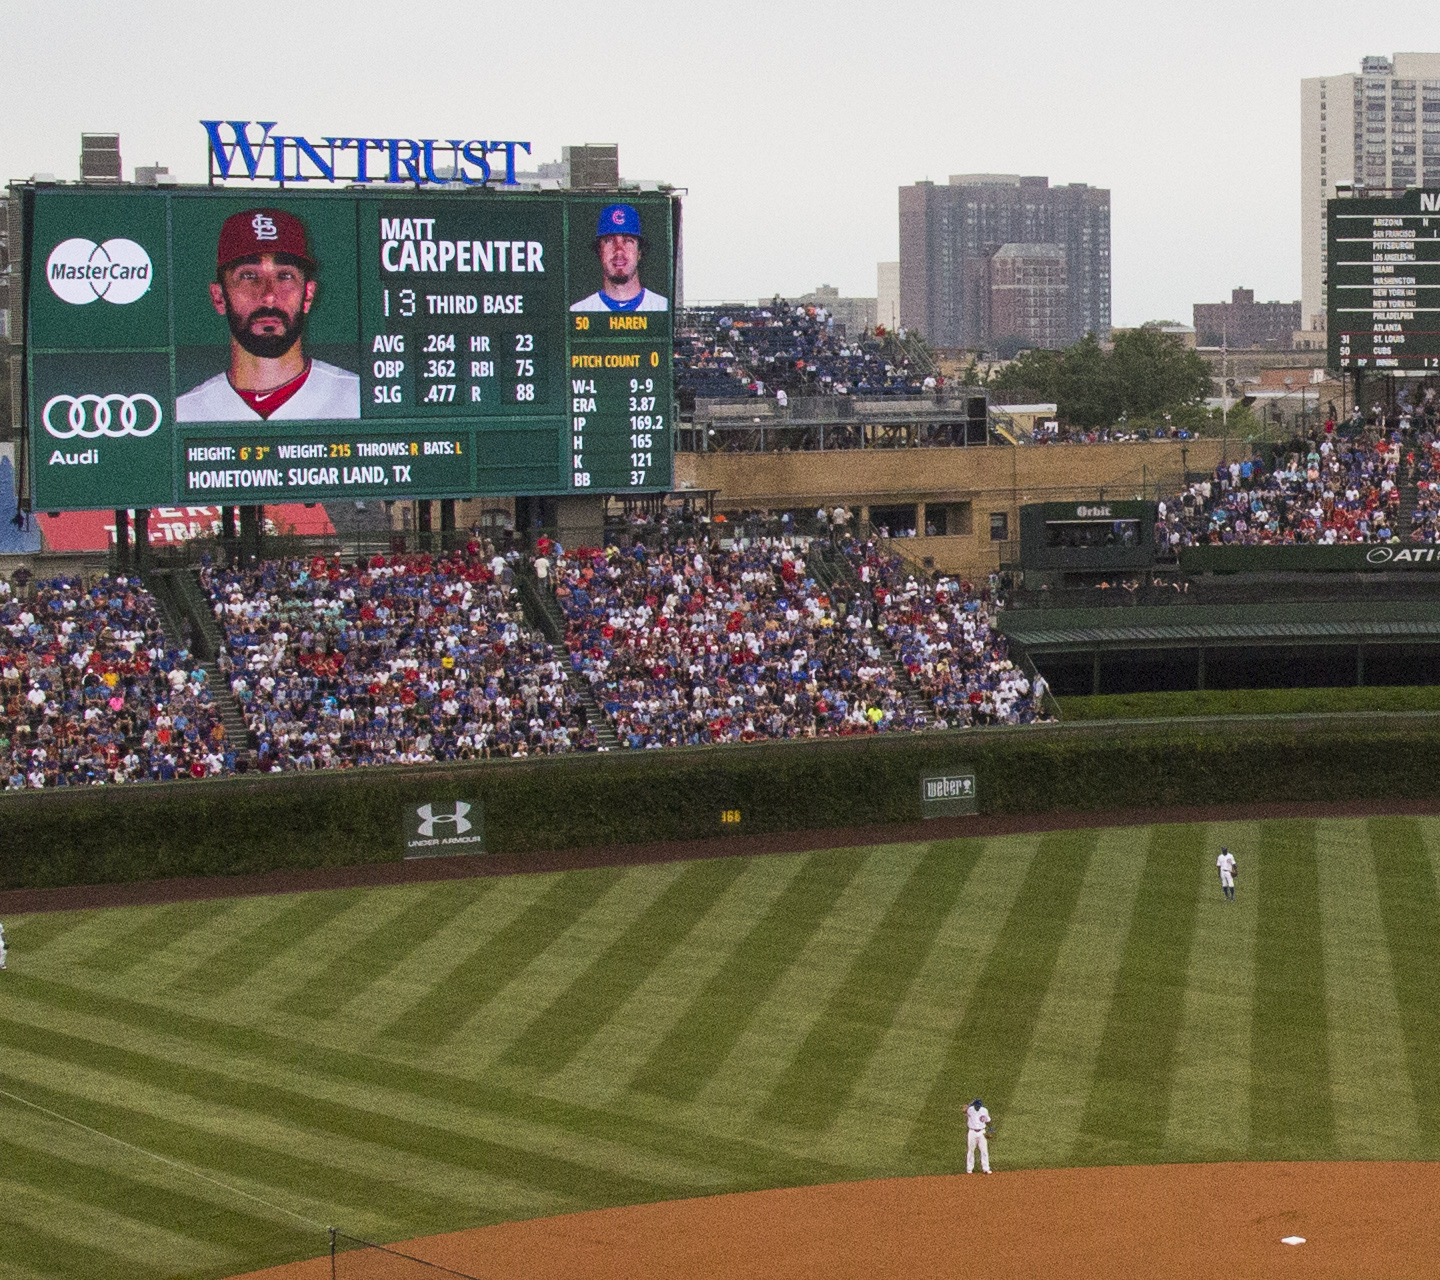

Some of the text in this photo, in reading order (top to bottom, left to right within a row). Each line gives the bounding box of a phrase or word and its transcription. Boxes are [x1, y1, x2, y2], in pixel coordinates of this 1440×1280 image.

[200, 120, 531, 185] WINTRUST
[381, 219, 435, 239] MATT
[381, 241, 544, 272] CARPENTER
[51, 264, 148, 280] MasterCard
[384, 289, 523, 316] 13 THIRD BASE
[576, 317, 647, 330] 50 HAREN
[373, 334, 533, 352] AVG .264 HR 23
[572, 352, 658, 367] PITCH COUNT 0
[374, 359, 533, 378] OBP .362 RBI 75
[374, 384, 534, 403] SLG .477 R 88
[572, 378, 653, 394] W-L 9-9
[573, 397, 655, 412] ERA 3.87
[574, 415, 663, 431] IP 169.2
[574, 434, 652, 449] H 165
[49, 449, 99, 465] Audi
[188, 446, 235, 461] HEIGHT:
[278, 444, 327, 458] WEIGHT:
[330, 444, 350, 458] 215
[357, 443, 408, 456] THROWS:
[410, 443, 418, 456] R
[424, 442, 453, 454] BATS:
[456, 442, 462, 454] L
[574, 453, 652, 468] K 121
[189, 465, 411, 488] HOMETOWN: SUGAR LAND, TX
[574, 471, 645, 486] BB 37
[1077, 505, 1112, 517] Orbit
[1393, 549, 1434, 561] ATI
[928, 777, 961, 797] weber
[408, 836, 480, 847] UNDER ARMOUR
